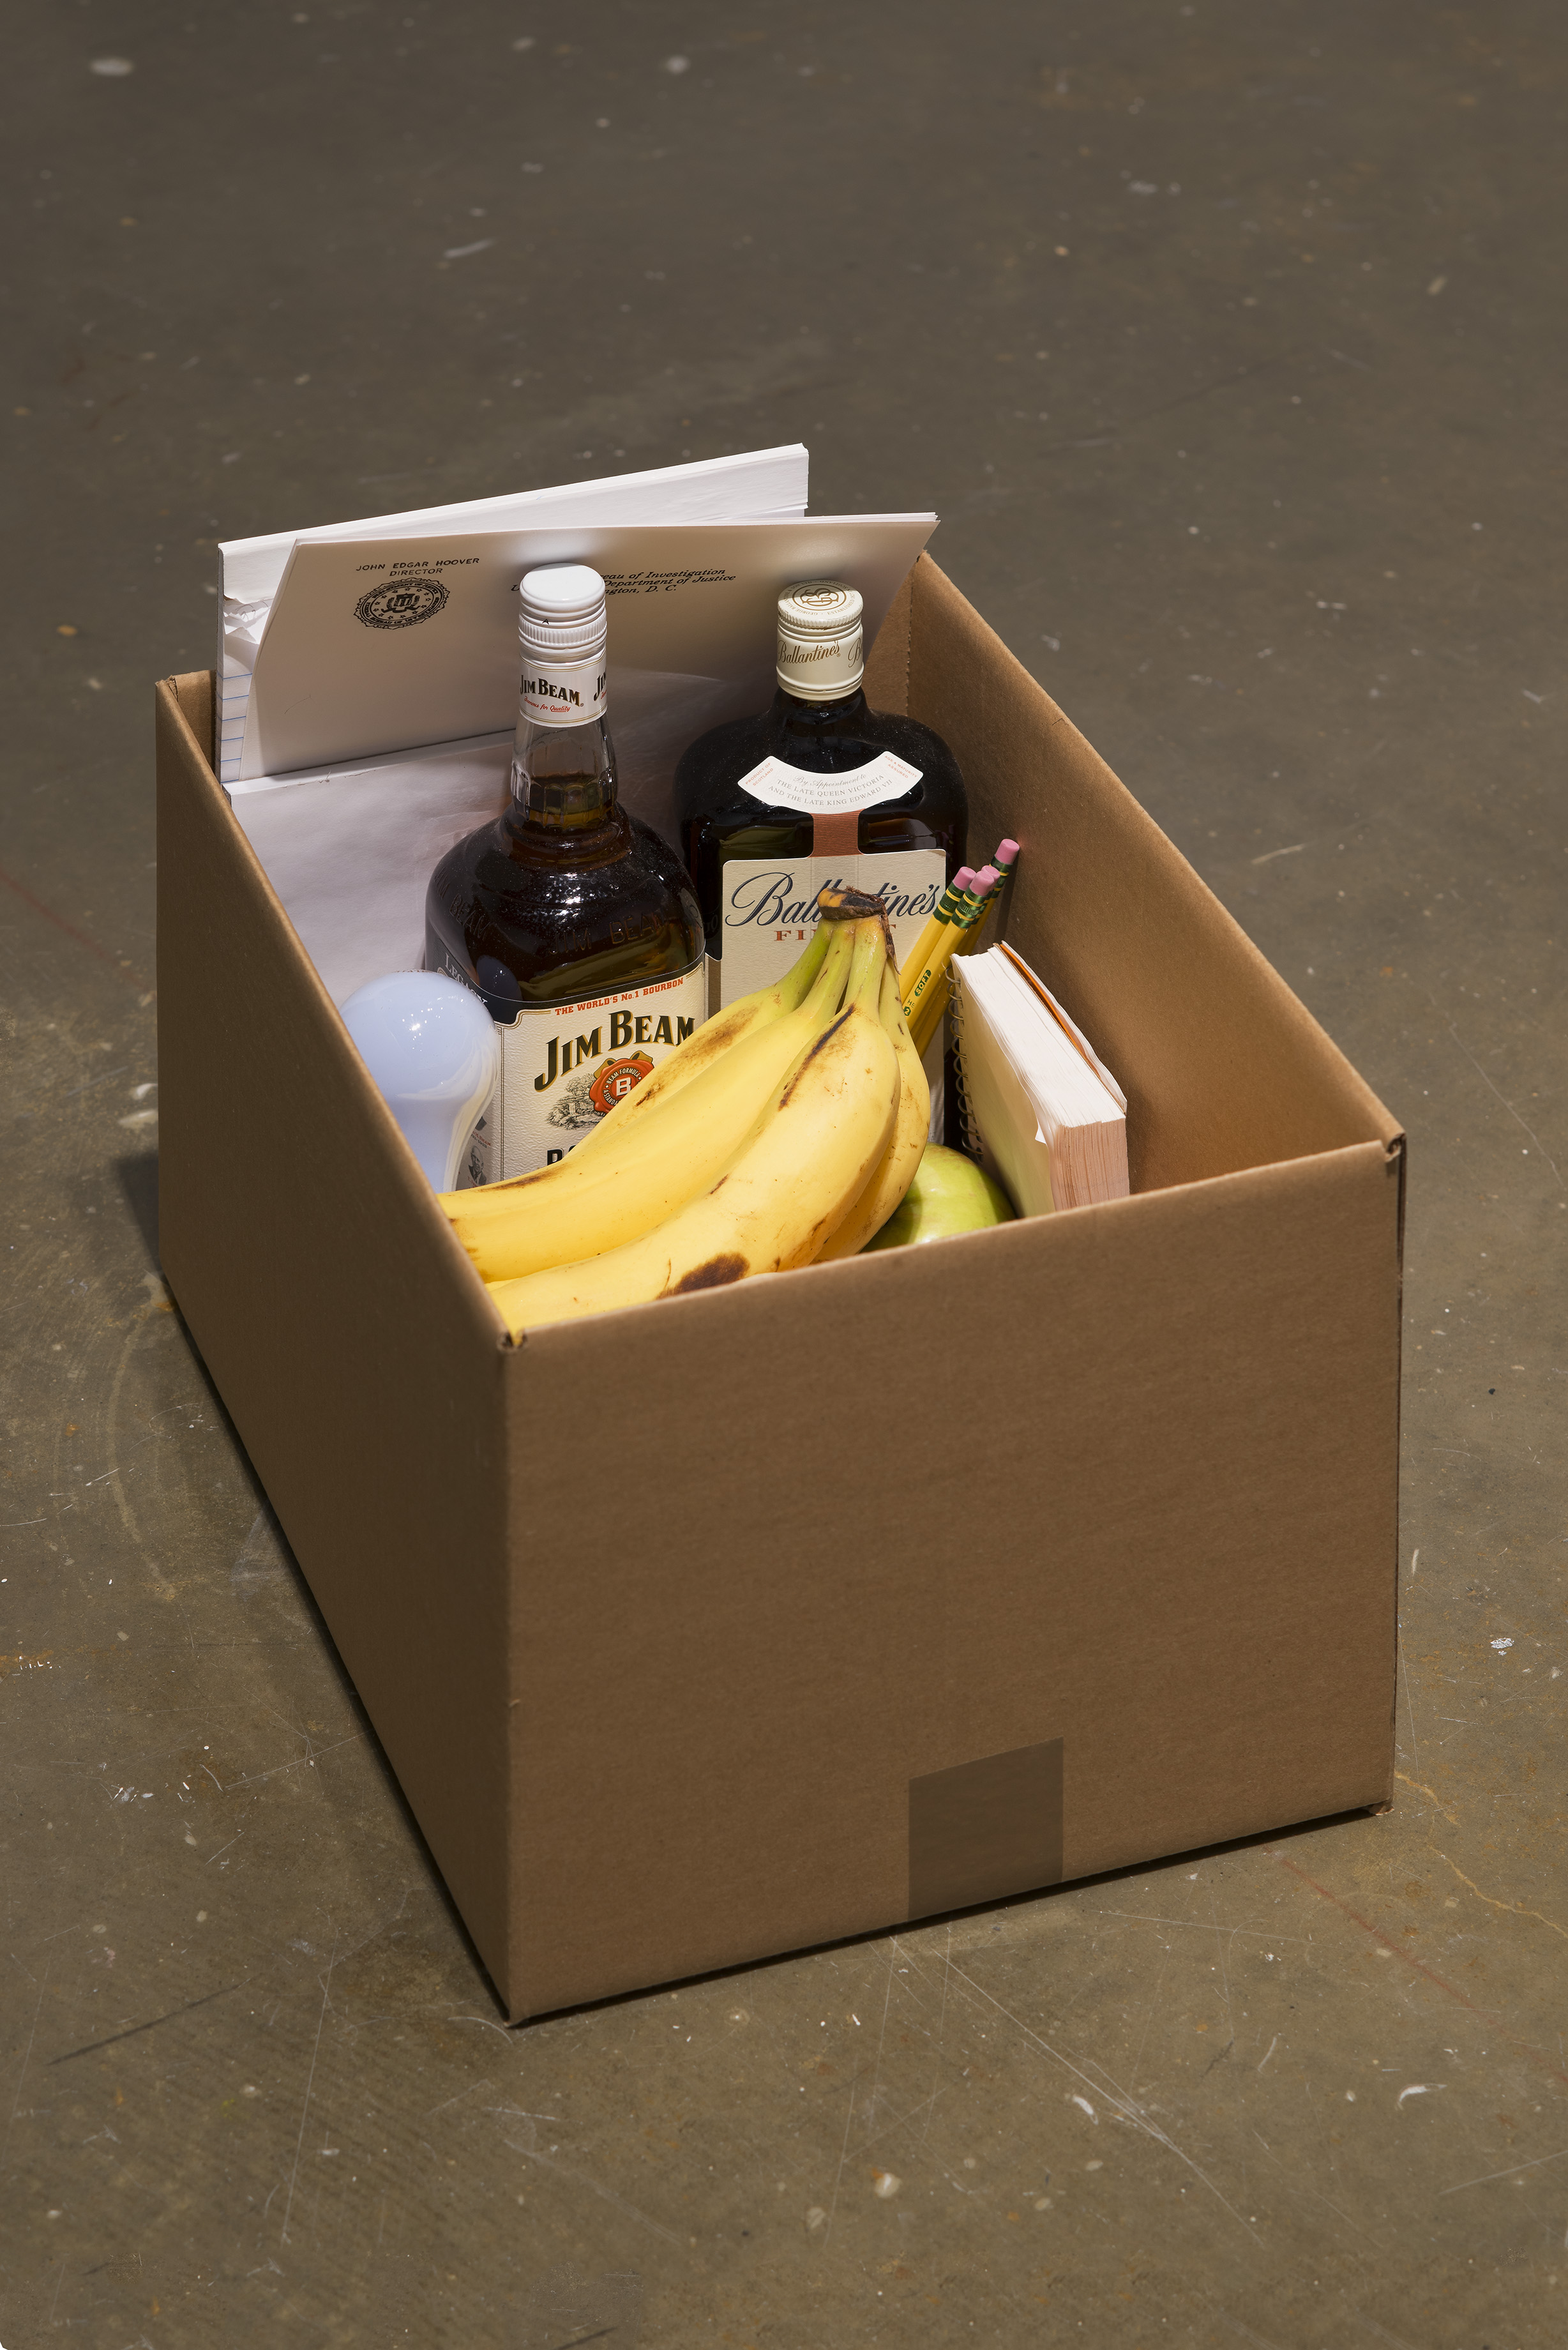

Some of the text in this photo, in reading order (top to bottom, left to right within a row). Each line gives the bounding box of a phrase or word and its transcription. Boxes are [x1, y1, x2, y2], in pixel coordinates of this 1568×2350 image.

[604, 578, 674, 588] Department
[692, 574, 736, 583] Justice
[645, 568, 726, 579] Investigation
[827, 598, 854, 615] ESTABLISHED
[778, 639, 840, 663] Ballantine's
[520, 674, 536, 695] JIM
[538, 678, 580, 707] BEAM
[746, 768, 764, 785] PRODUCT
[753, 768, 773, 786] SCOTLAND
[888, 764, 908, 778] ASSURED
[898, 764, 917, 778] MATURITY
[777, 779, 792, 789] THE
[794, 786, 815, 795] LATE
[848, 775, 884, 793] VICTORIA
[793, 775, 808, 786] By
[810, 773, 861, 789] Appointment
[768, 786, 785, 796] AND
[787, 793, 802, 801] THE
[850, 787, 881, 803] EDWARD
[882, 779, 893, 787] VII
[725, 872, 940, 927] Balltine's
[916, 972, 930, 994] SOFT
[555, 1006, 574, 1015] THE
[577, 996, 618, 1011] WORLD'S
[643, 978, 684, 996] BOURBON
[534, 1010, 695, 1092] JIM BEAM
[607, 1067, 641, 1084] BEAM FORMULA
[615, 1077, 631, 1096] B
[603, 1093, 620, 1106] STANDA
